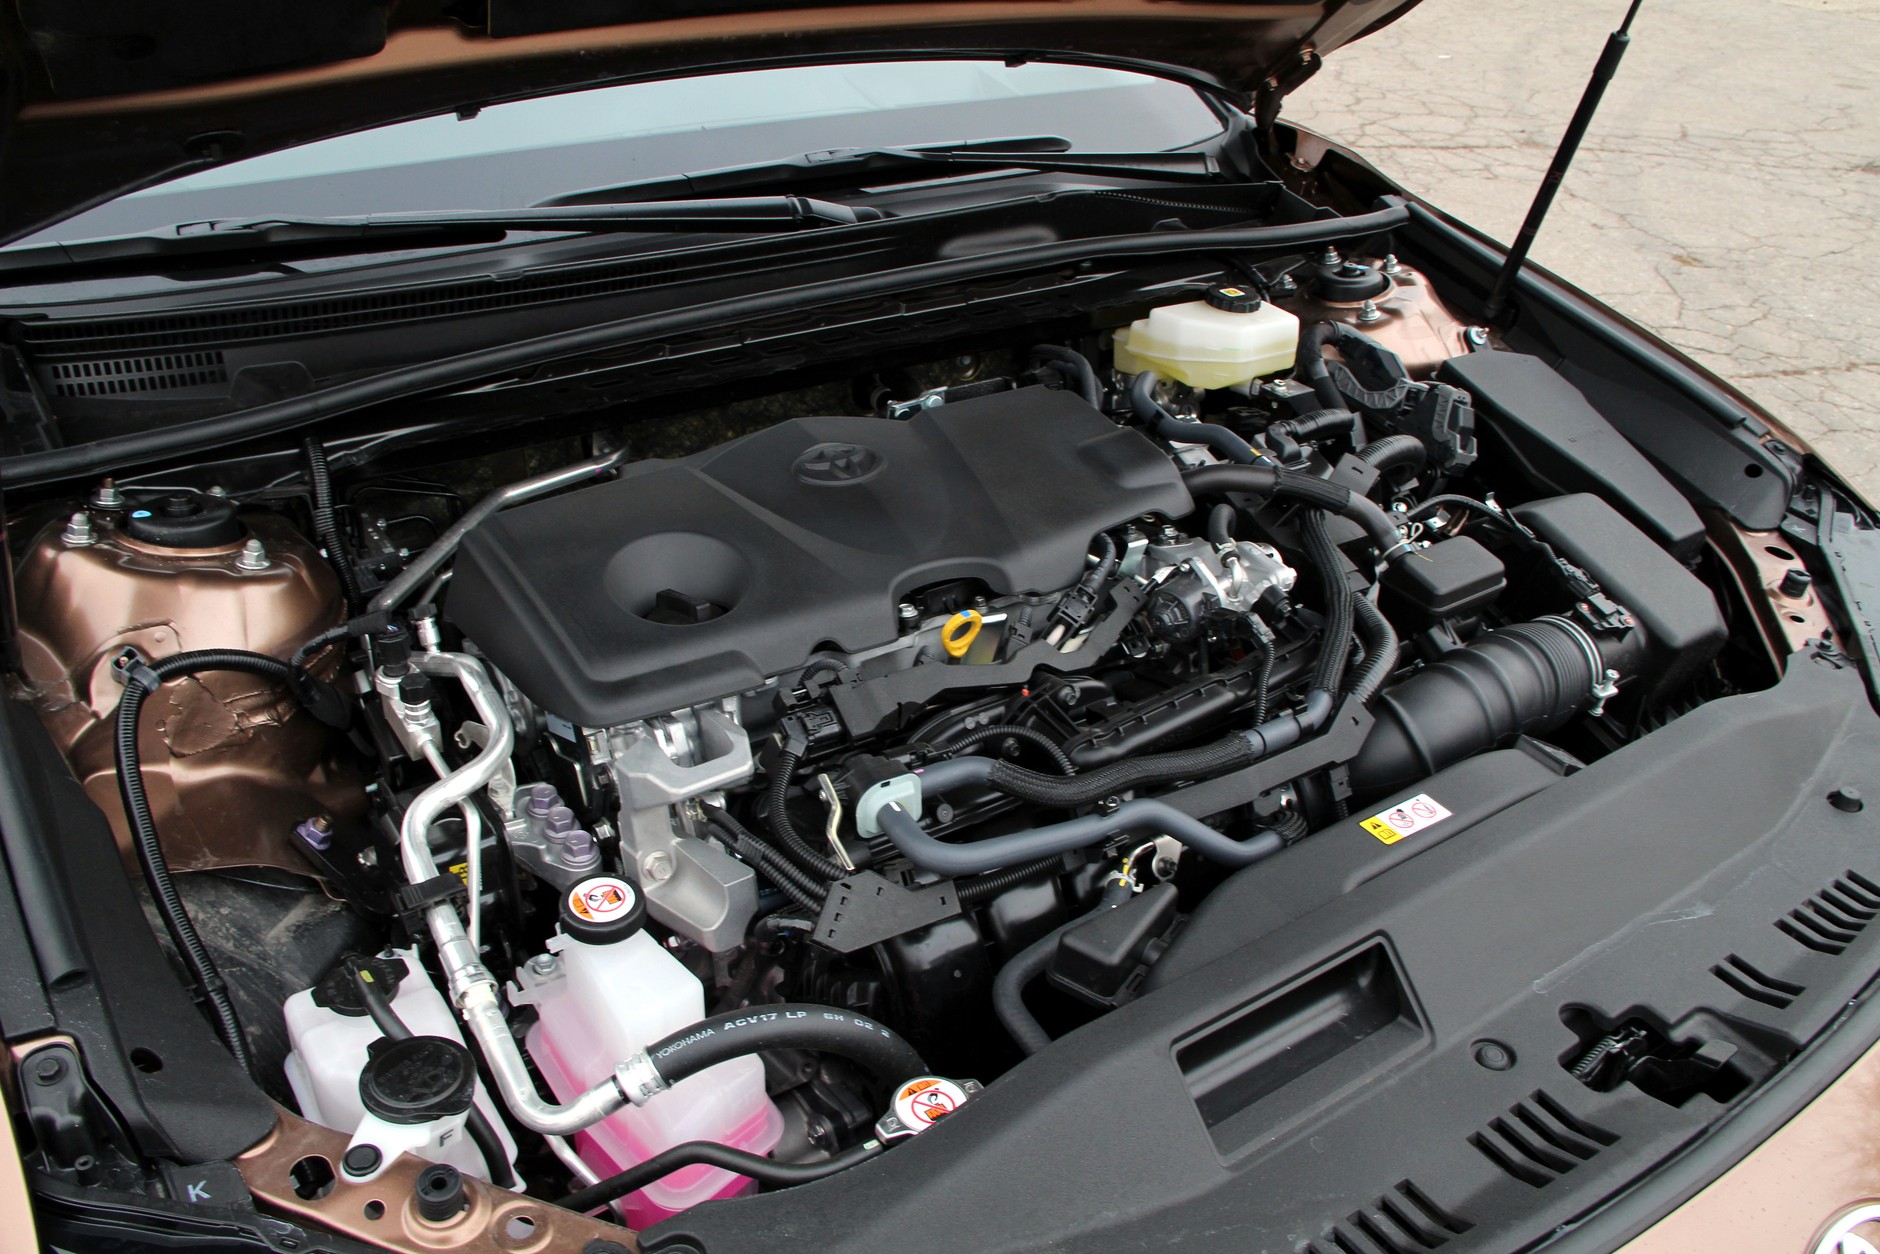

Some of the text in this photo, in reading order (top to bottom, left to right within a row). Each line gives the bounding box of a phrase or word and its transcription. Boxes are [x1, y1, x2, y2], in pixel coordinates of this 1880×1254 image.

[655, 1028, 716, 1059] YOKOHAMA
[723, 1012, 779, 1031] ACV17
[785, 1011, 807, 1019] LP
[439, 1128, 455, 1148] F
[186, 1179, 212, 1203] K
